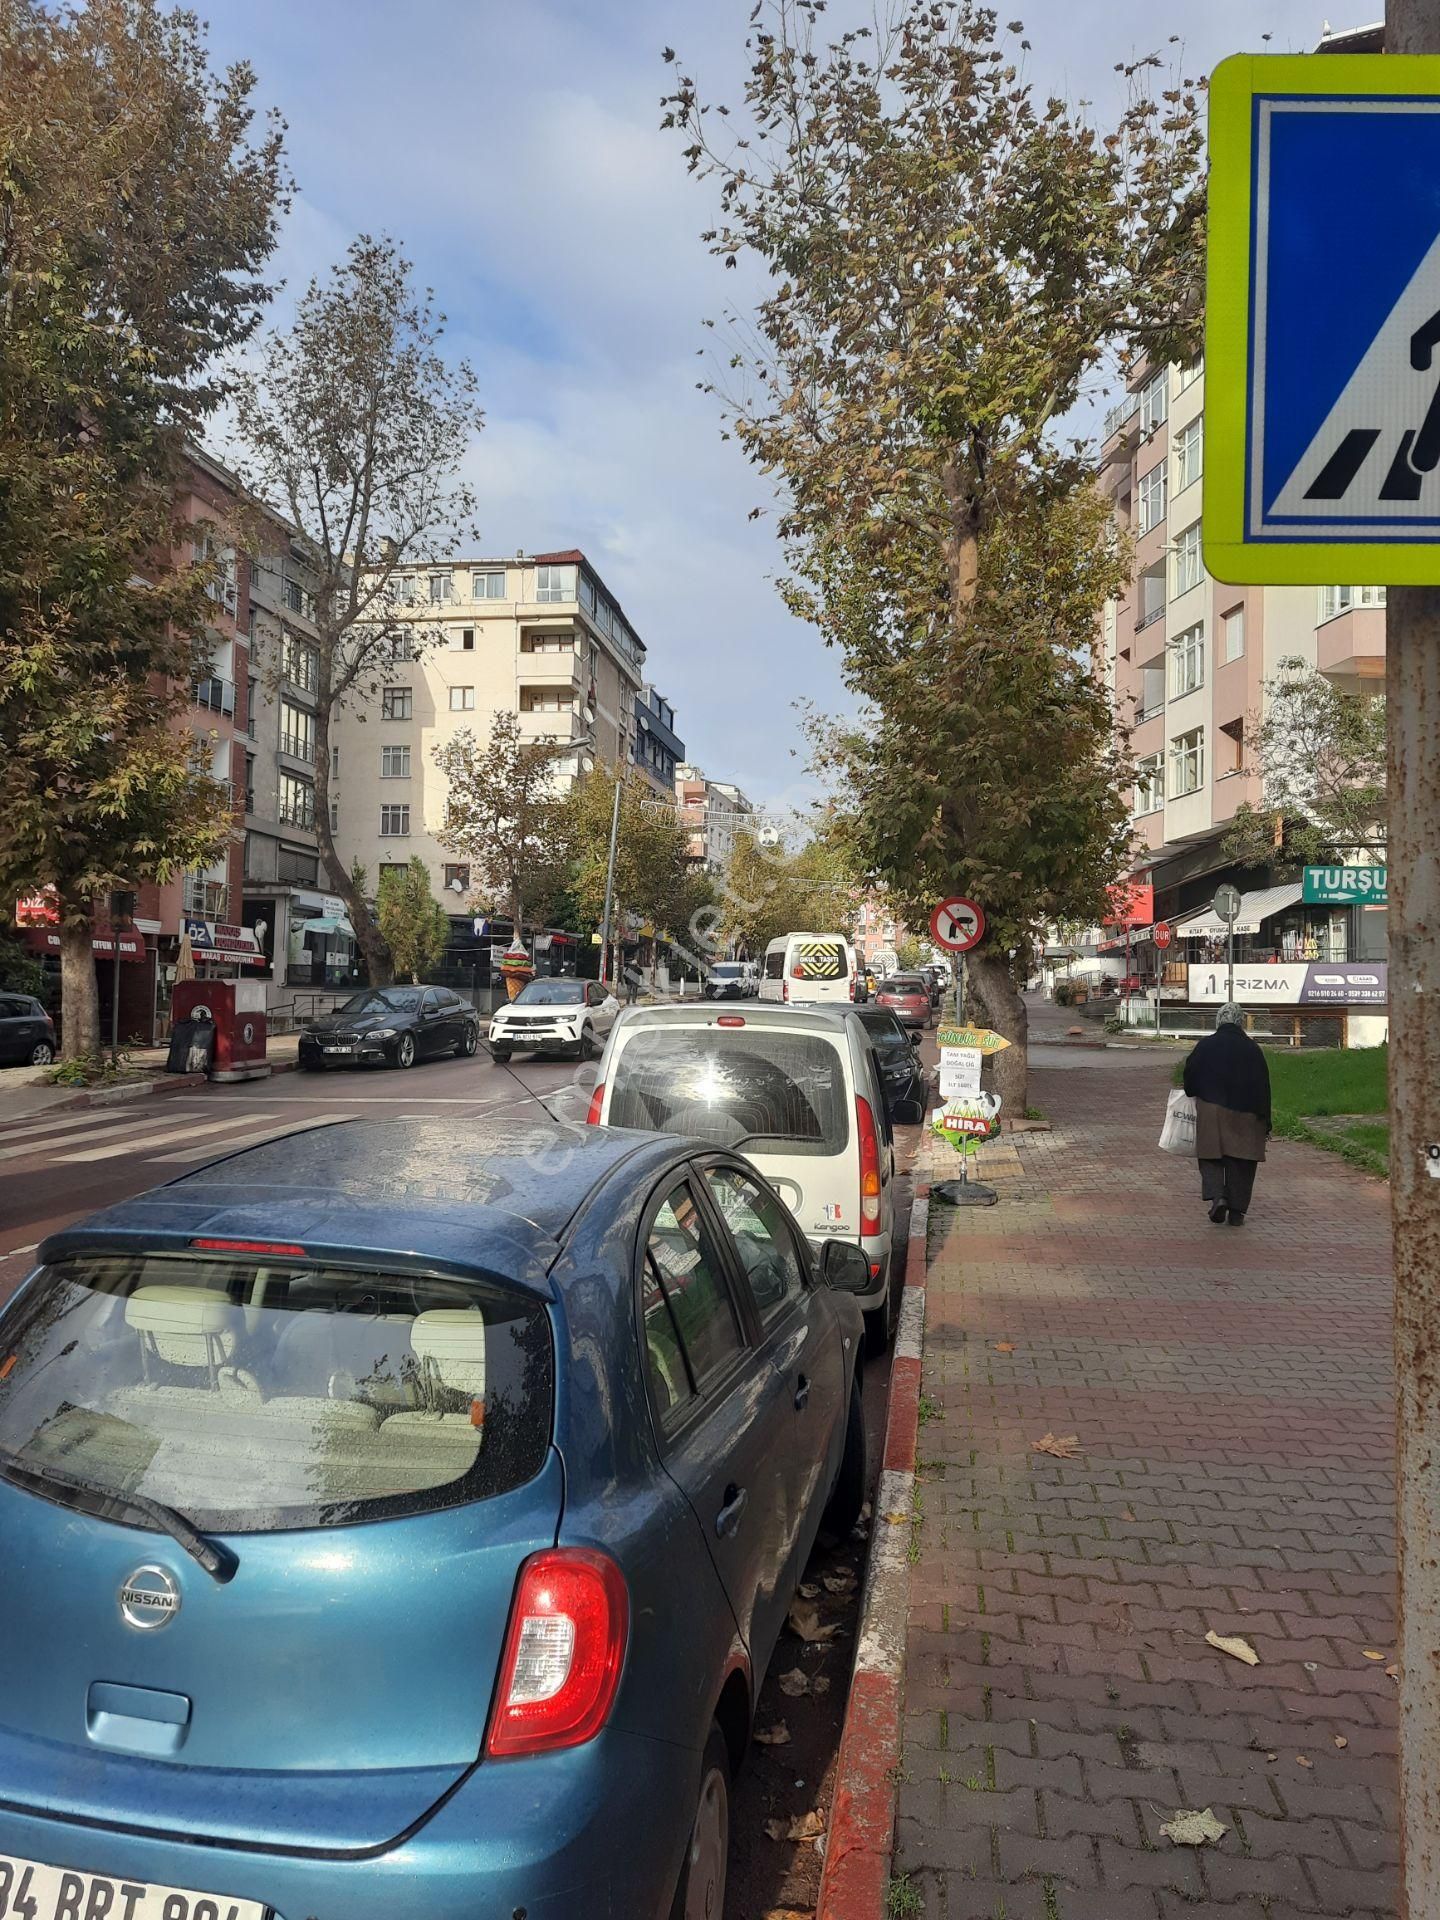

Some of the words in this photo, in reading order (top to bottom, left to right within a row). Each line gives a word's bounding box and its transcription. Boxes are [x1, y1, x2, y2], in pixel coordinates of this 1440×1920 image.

[1309, 869, 1388, 895] TURŞU
[188, 923, 206, 942] ÖZ
[1155, 929, 1169, 941] DUR
[946, 1117, 987, 1133] HİRA
[814, 1222, 850, 1233] Kangoo
[121, 1590, 173, 1607] NISSAN
